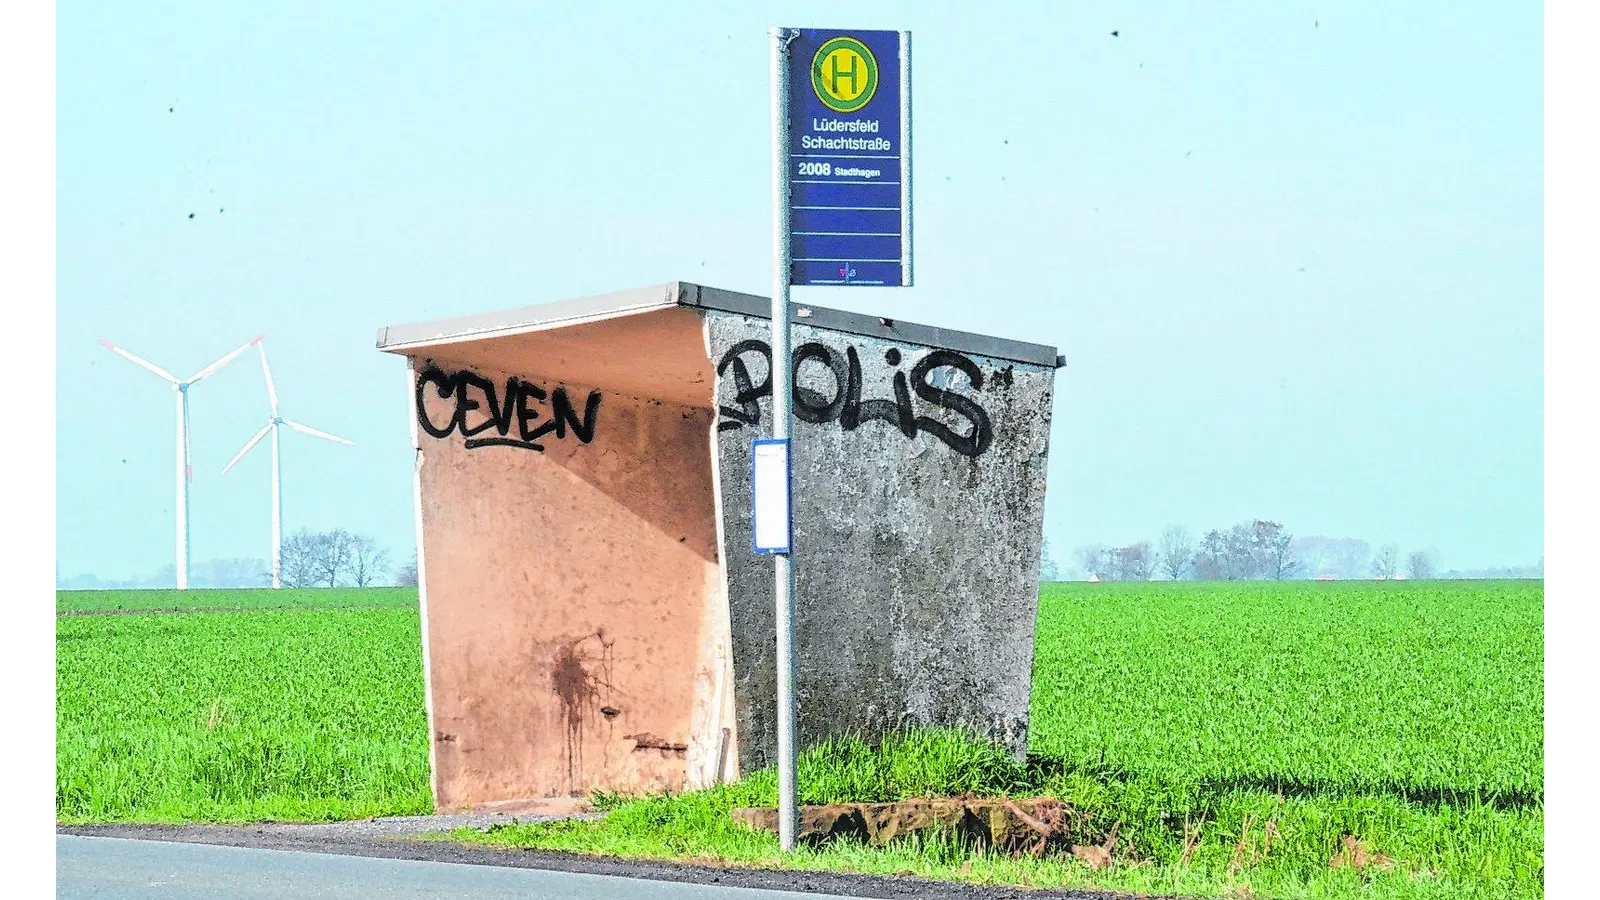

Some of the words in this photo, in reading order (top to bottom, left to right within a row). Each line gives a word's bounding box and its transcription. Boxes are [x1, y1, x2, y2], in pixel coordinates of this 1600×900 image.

[831, 55, 857, 94] H
[813, 118, 879, 133] Lüdersfeld
[801, 135, 891, 151] Schachtstraße
[798, 162, 831, 176] 2008
[834, 167, 881, 178] Stadthagen
[416, 364, 602, 443] CEVEN
